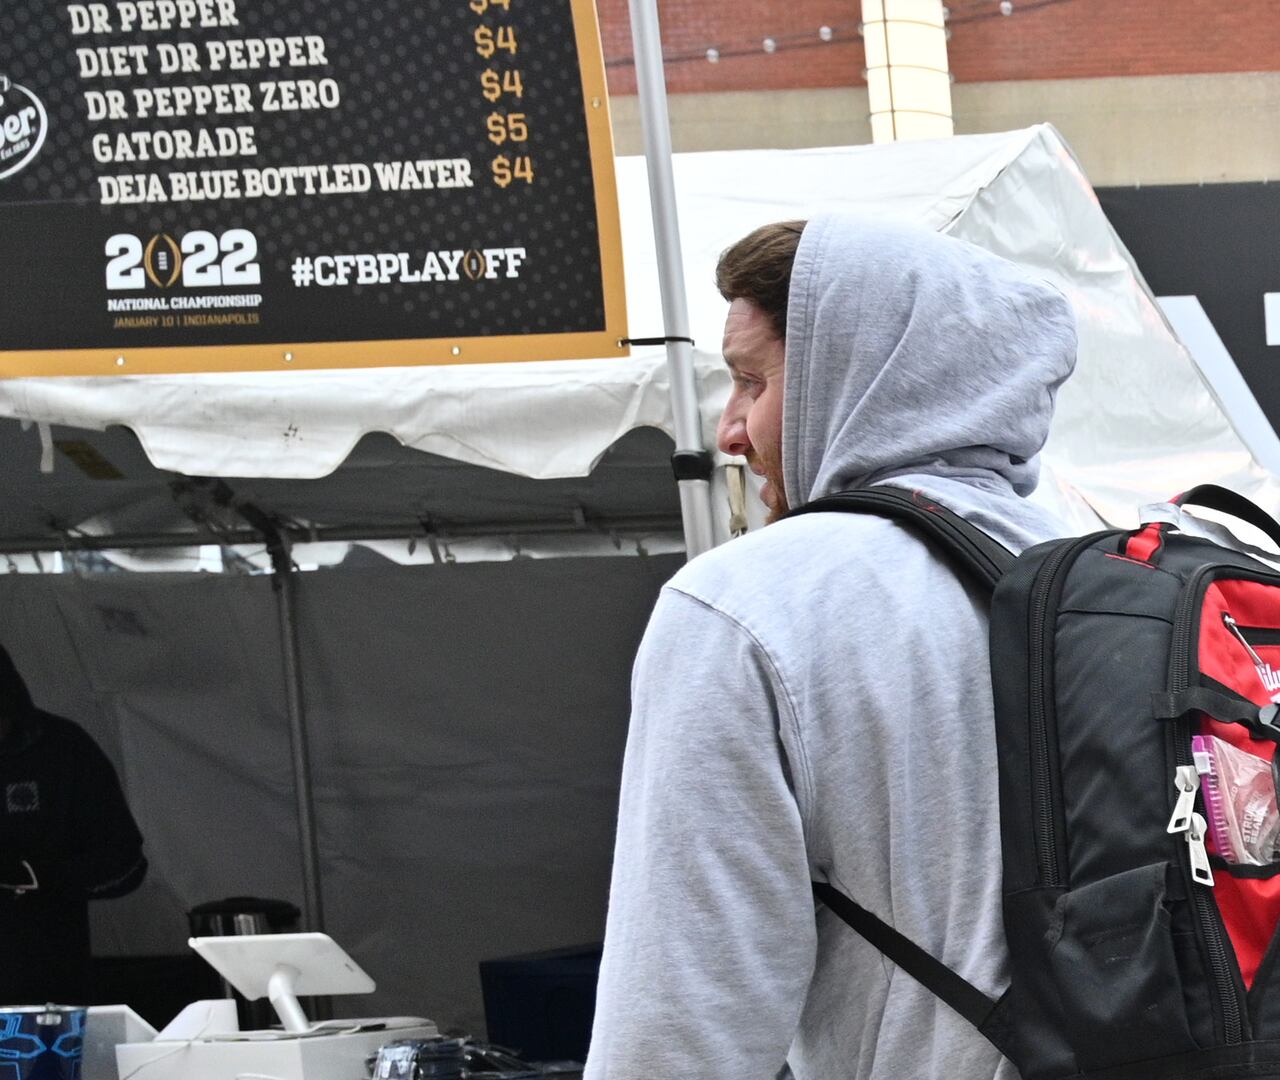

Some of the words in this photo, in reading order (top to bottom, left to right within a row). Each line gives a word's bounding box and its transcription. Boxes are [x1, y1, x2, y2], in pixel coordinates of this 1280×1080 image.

[67, 3, 113, 35] DR
[117, 0, 239, 32] PEPPER
[76, 45, 148, 78] DIET
[156, 43, 201, 74] DR
[205, 35, 328, 71] PEPPER
[473, 24, 518, 59] $4
[84, 90, 129, 121] DR
[133, 83, 254, 118] PEPPER
[259, 78, 341, 111] ZERO
[480, 68, 523, 102] $4
[92, 126, 258, 163] GATORADE
[487, 111, 529, 145] $5
[98, 173, 167, 204] DEJA
[169, 169, 242, 201] BLUE
[243, 163, 371, 197] BOTTLED
[373, 158, 474, 191] WATER
[491, 154, 534, 188] $4
[107, 297, 169, 312] NATIONAL
[170, 294, 262, 311] CHAMPIONSHIP
[114, 314, 160, 328] JANUARY
[161, 314, 175, 326] 10
[182, 312, 259, 326] INDIANAPOLIS
